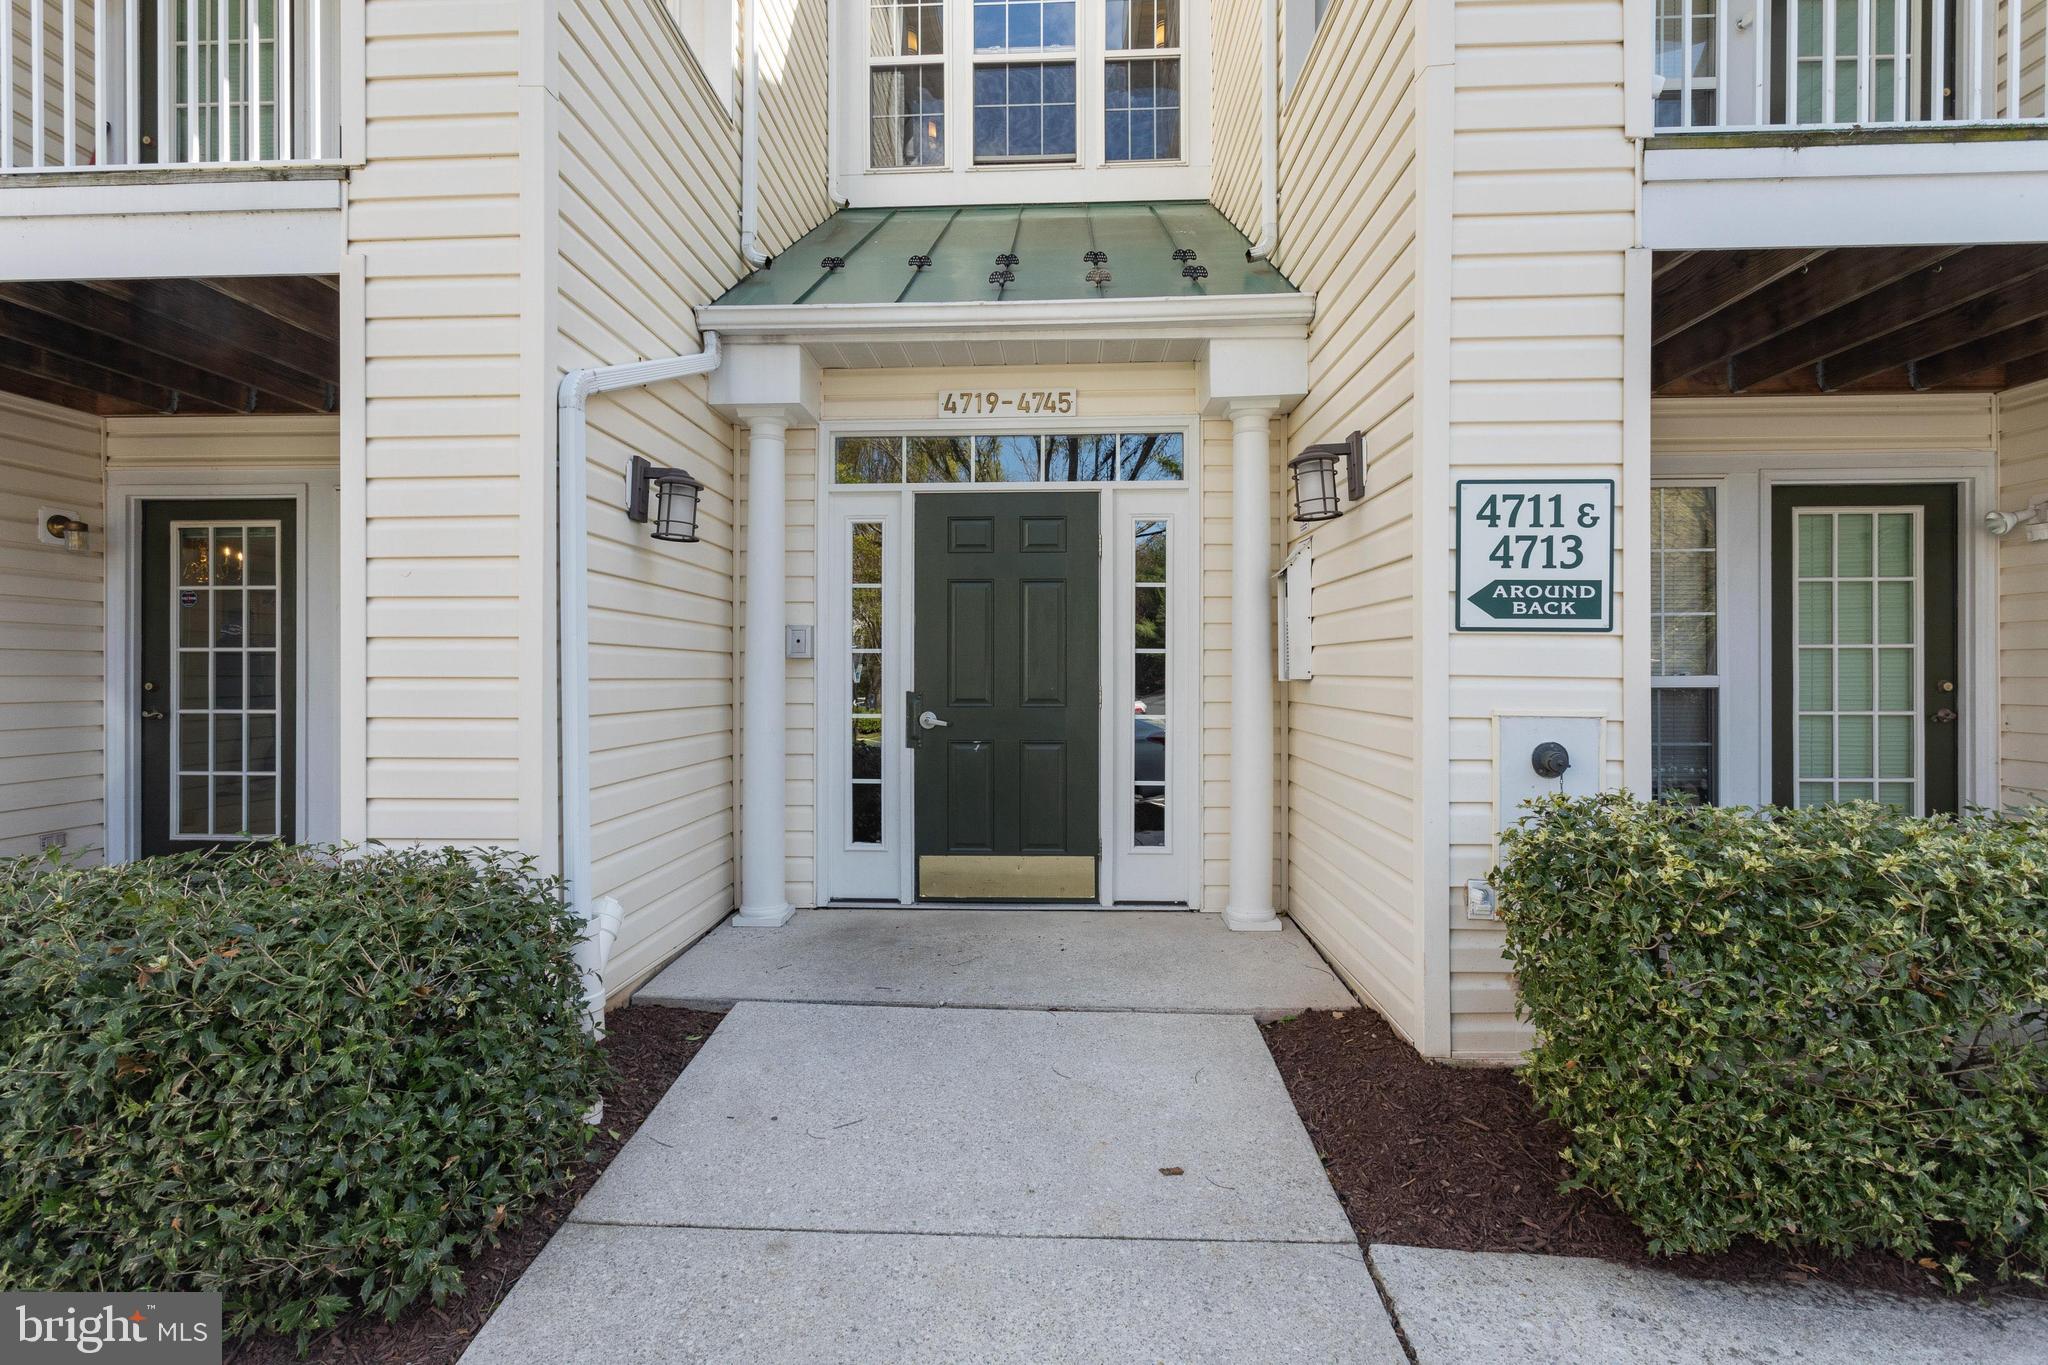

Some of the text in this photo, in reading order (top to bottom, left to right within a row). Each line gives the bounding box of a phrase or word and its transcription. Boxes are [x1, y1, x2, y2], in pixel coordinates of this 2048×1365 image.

[943, 392, 1072, 414] 4719-4745
[1476, 494, 1600, 528] 4711 &
[1489, 534, 1584, 569] 4713
[1492, 585, 1596, 598] AROUND
[1512, 601, 1576, 615] BACK
